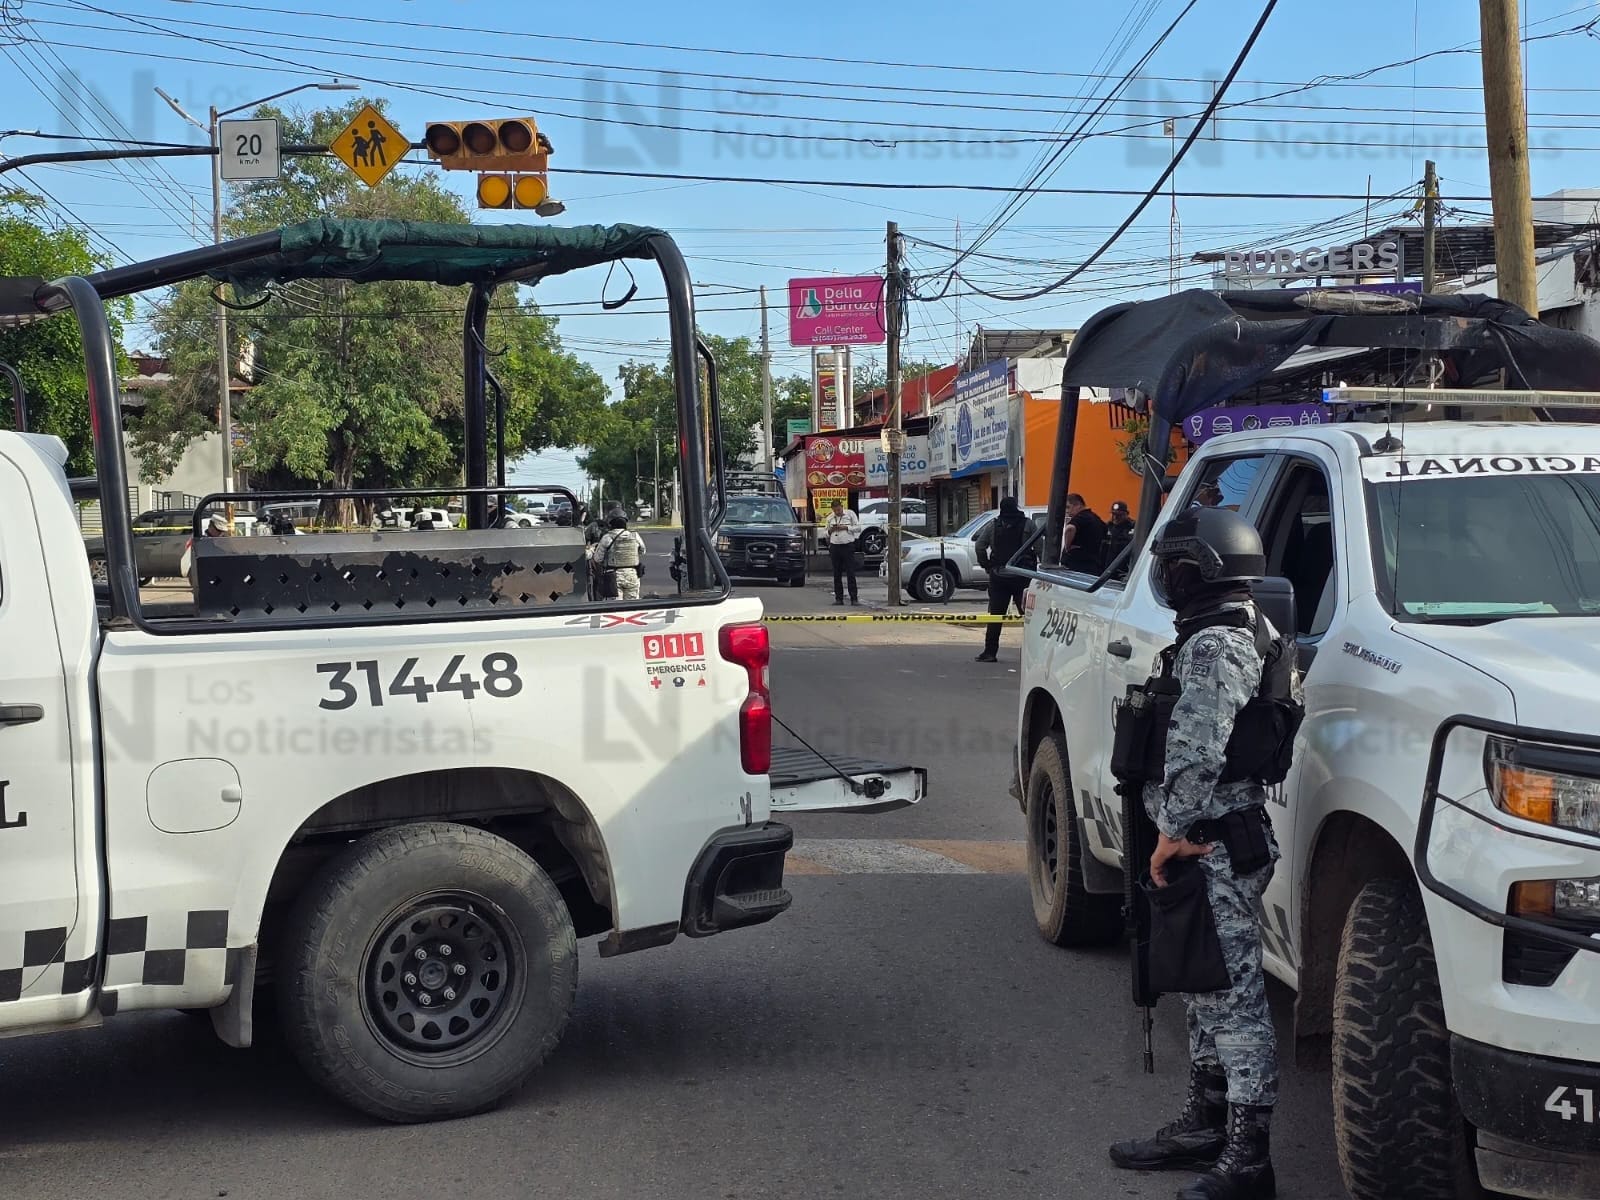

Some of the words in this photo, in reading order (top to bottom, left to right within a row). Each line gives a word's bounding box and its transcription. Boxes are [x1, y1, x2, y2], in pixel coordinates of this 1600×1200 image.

[236, 134, 262, 156] 20
[1224, 242, 1399, 277] BURGERS
[825, 287, 862, 299] Delia
[815, 327, 832, 335] Call
[646, 634, 700, 656] 911
[647, 663, 707, 675] EMERGENCIAS
[316, 651, 523, 711] 31448
[1545, 1086, 1600, 1123] 41
